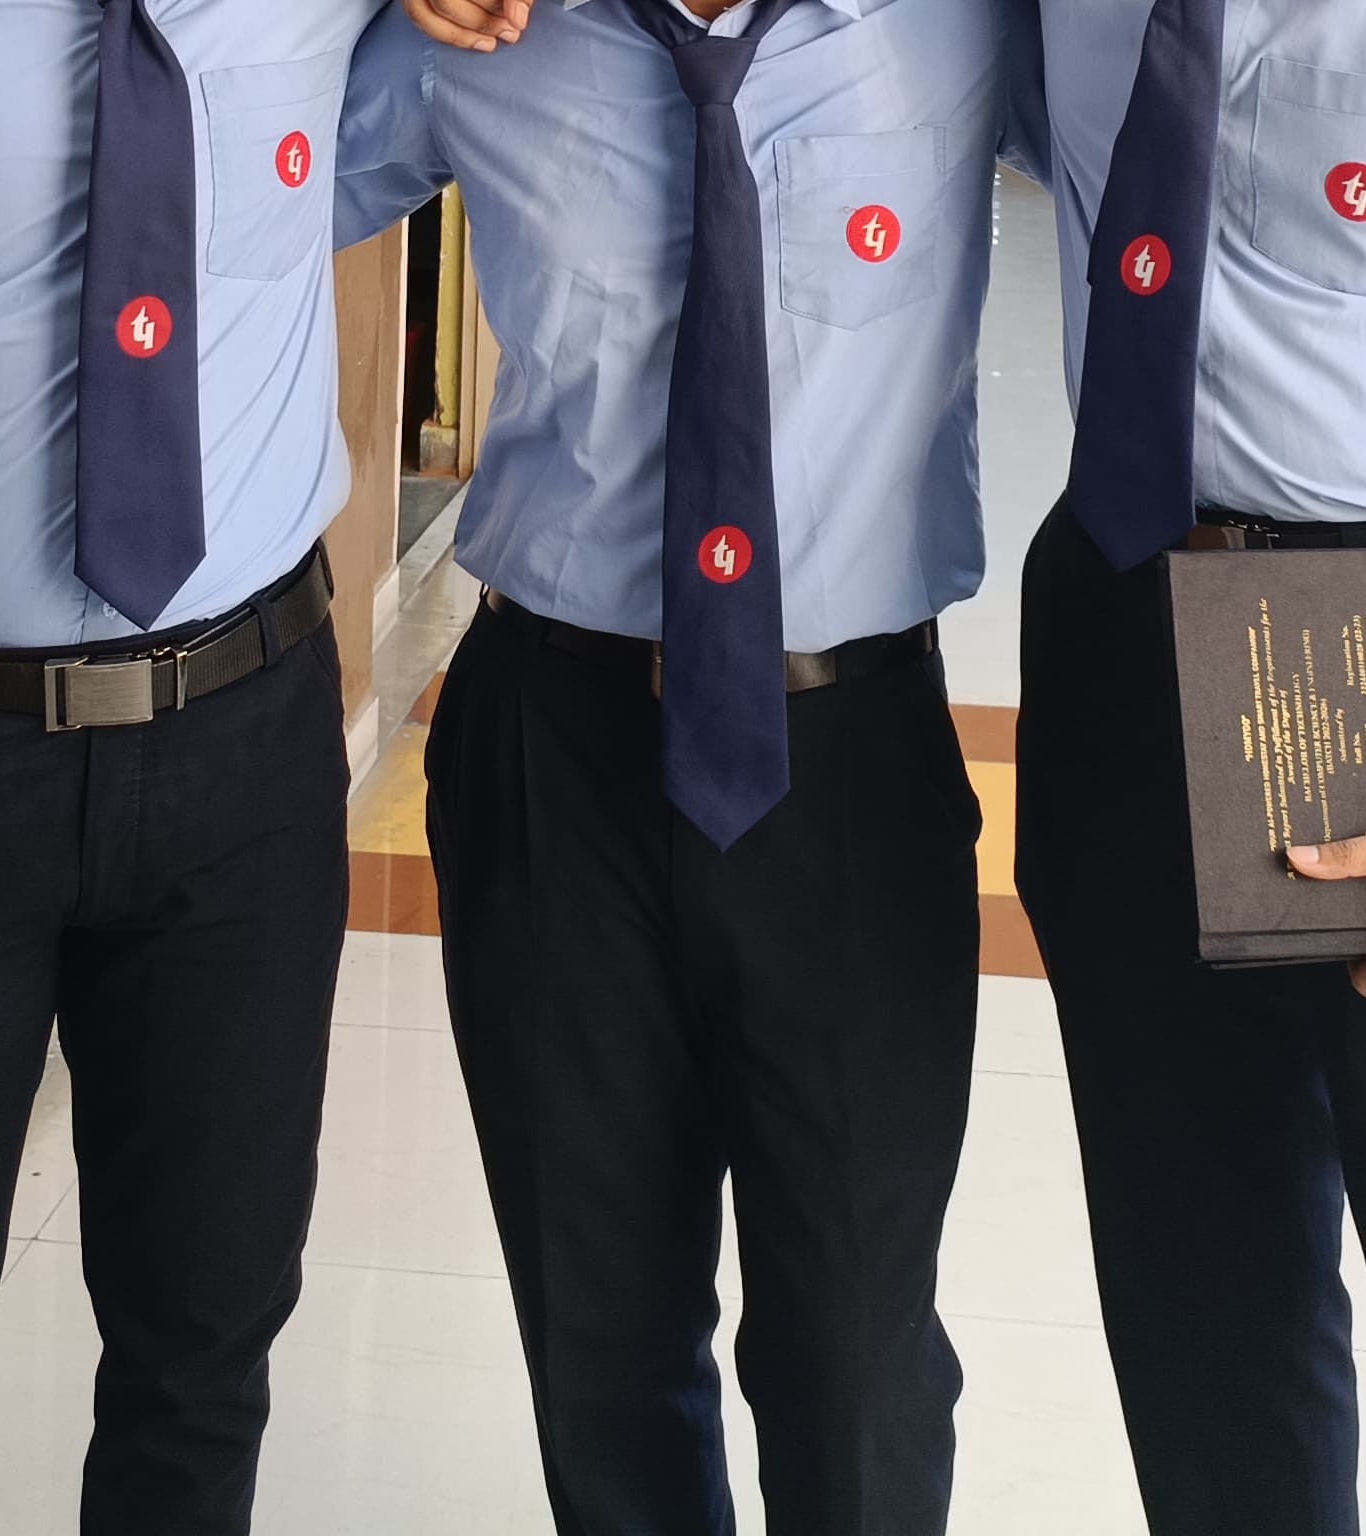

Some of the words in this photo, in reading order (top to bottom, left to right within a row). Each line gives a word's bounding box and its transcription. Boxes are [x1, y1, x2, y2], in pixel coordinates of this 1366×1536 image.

[1259, 598, 1267, 611] the
[1260, 613, 1271, 626] for
[1262, 626, 1275, 681] Requirements
[1343, 640, 1355, 686] Registration
[1267, 683, 1276, 698] the
[1279, 689, 1288, 698] of
[1268, 697, 1279, 707] of
[1292, 672, 1306, 737] TECHNOLOGY
[1255, 700, 1264, 724] SMART
[1281, 699, 1290, 728] Degree
[1335, 708, 1344, 720] by
[1258, 725, 1266, 742] AND
[1282, 730, 1291, 744] the
[1335, 719, 1347, 762] Submitted
[1284, 744, 1294, 754] of
[1299, 736, 1306, 750] OF
[1276, 755, 1283, 764] in
[1284, 753, 1296, 784] Award
[1300, 751, 1312, 802] BACHELOR
[1275, 763, 1288, 808] Submitted
[1281, 809, 1292, 838] Report
